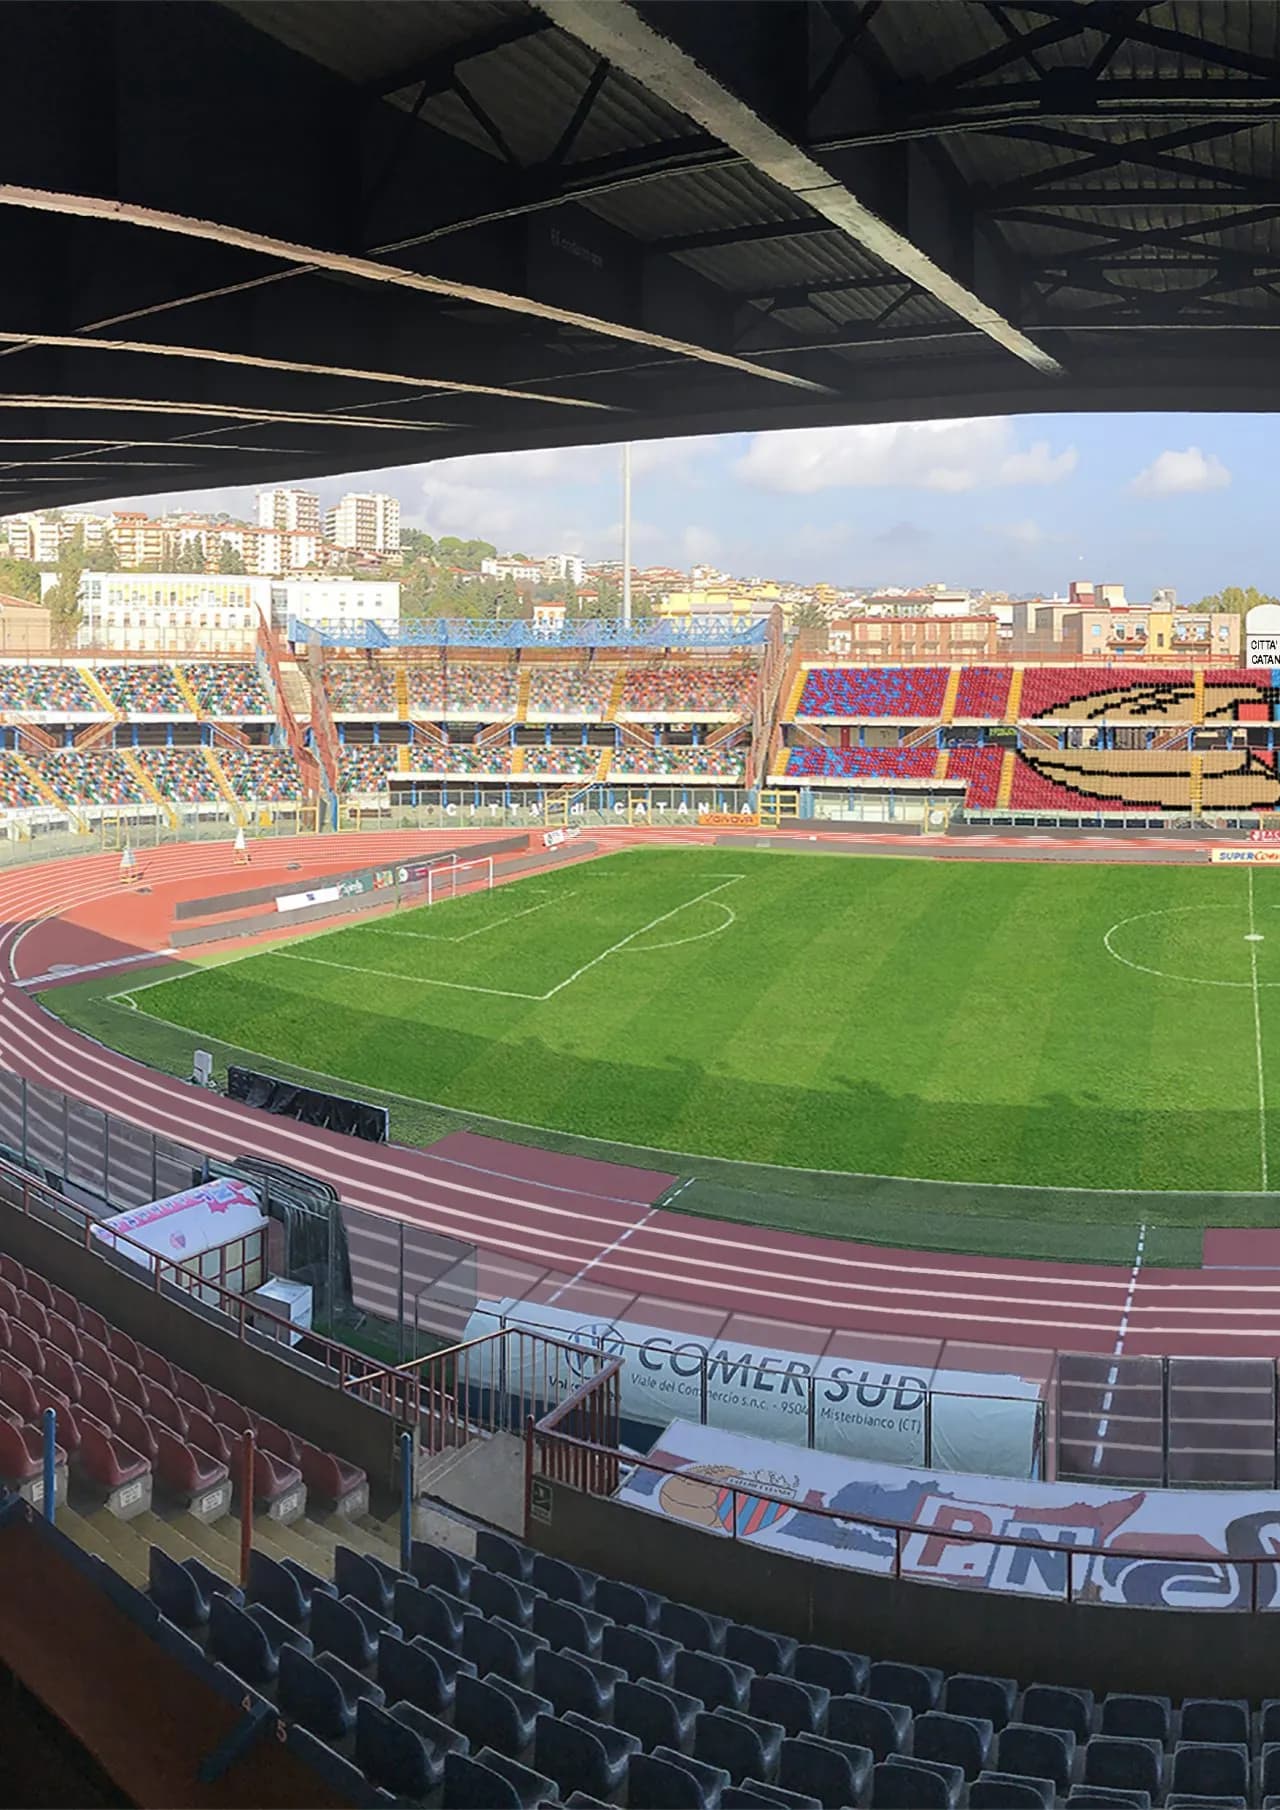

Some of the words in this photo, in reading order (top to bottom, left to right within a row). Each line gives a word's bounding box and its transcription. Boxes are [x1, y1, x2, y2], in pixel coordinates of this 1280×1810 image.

[1251, 640, 1278, 650] CITTA'
[570, 803, 584, 816] di
[614, 802, 752, 816] CATANIA
[639, 1337, 811, 1396] COMER
[824, 1367, 927, 1411] SUD
[632, 1373, 657, 1388] Viale
[660, 1380, 676, 1392] del
[821, 1407, 895, 1429] Misterbianco
[898, 1418, 921, 1434] (CT)
[241, 1695, 251, 1712] 4
